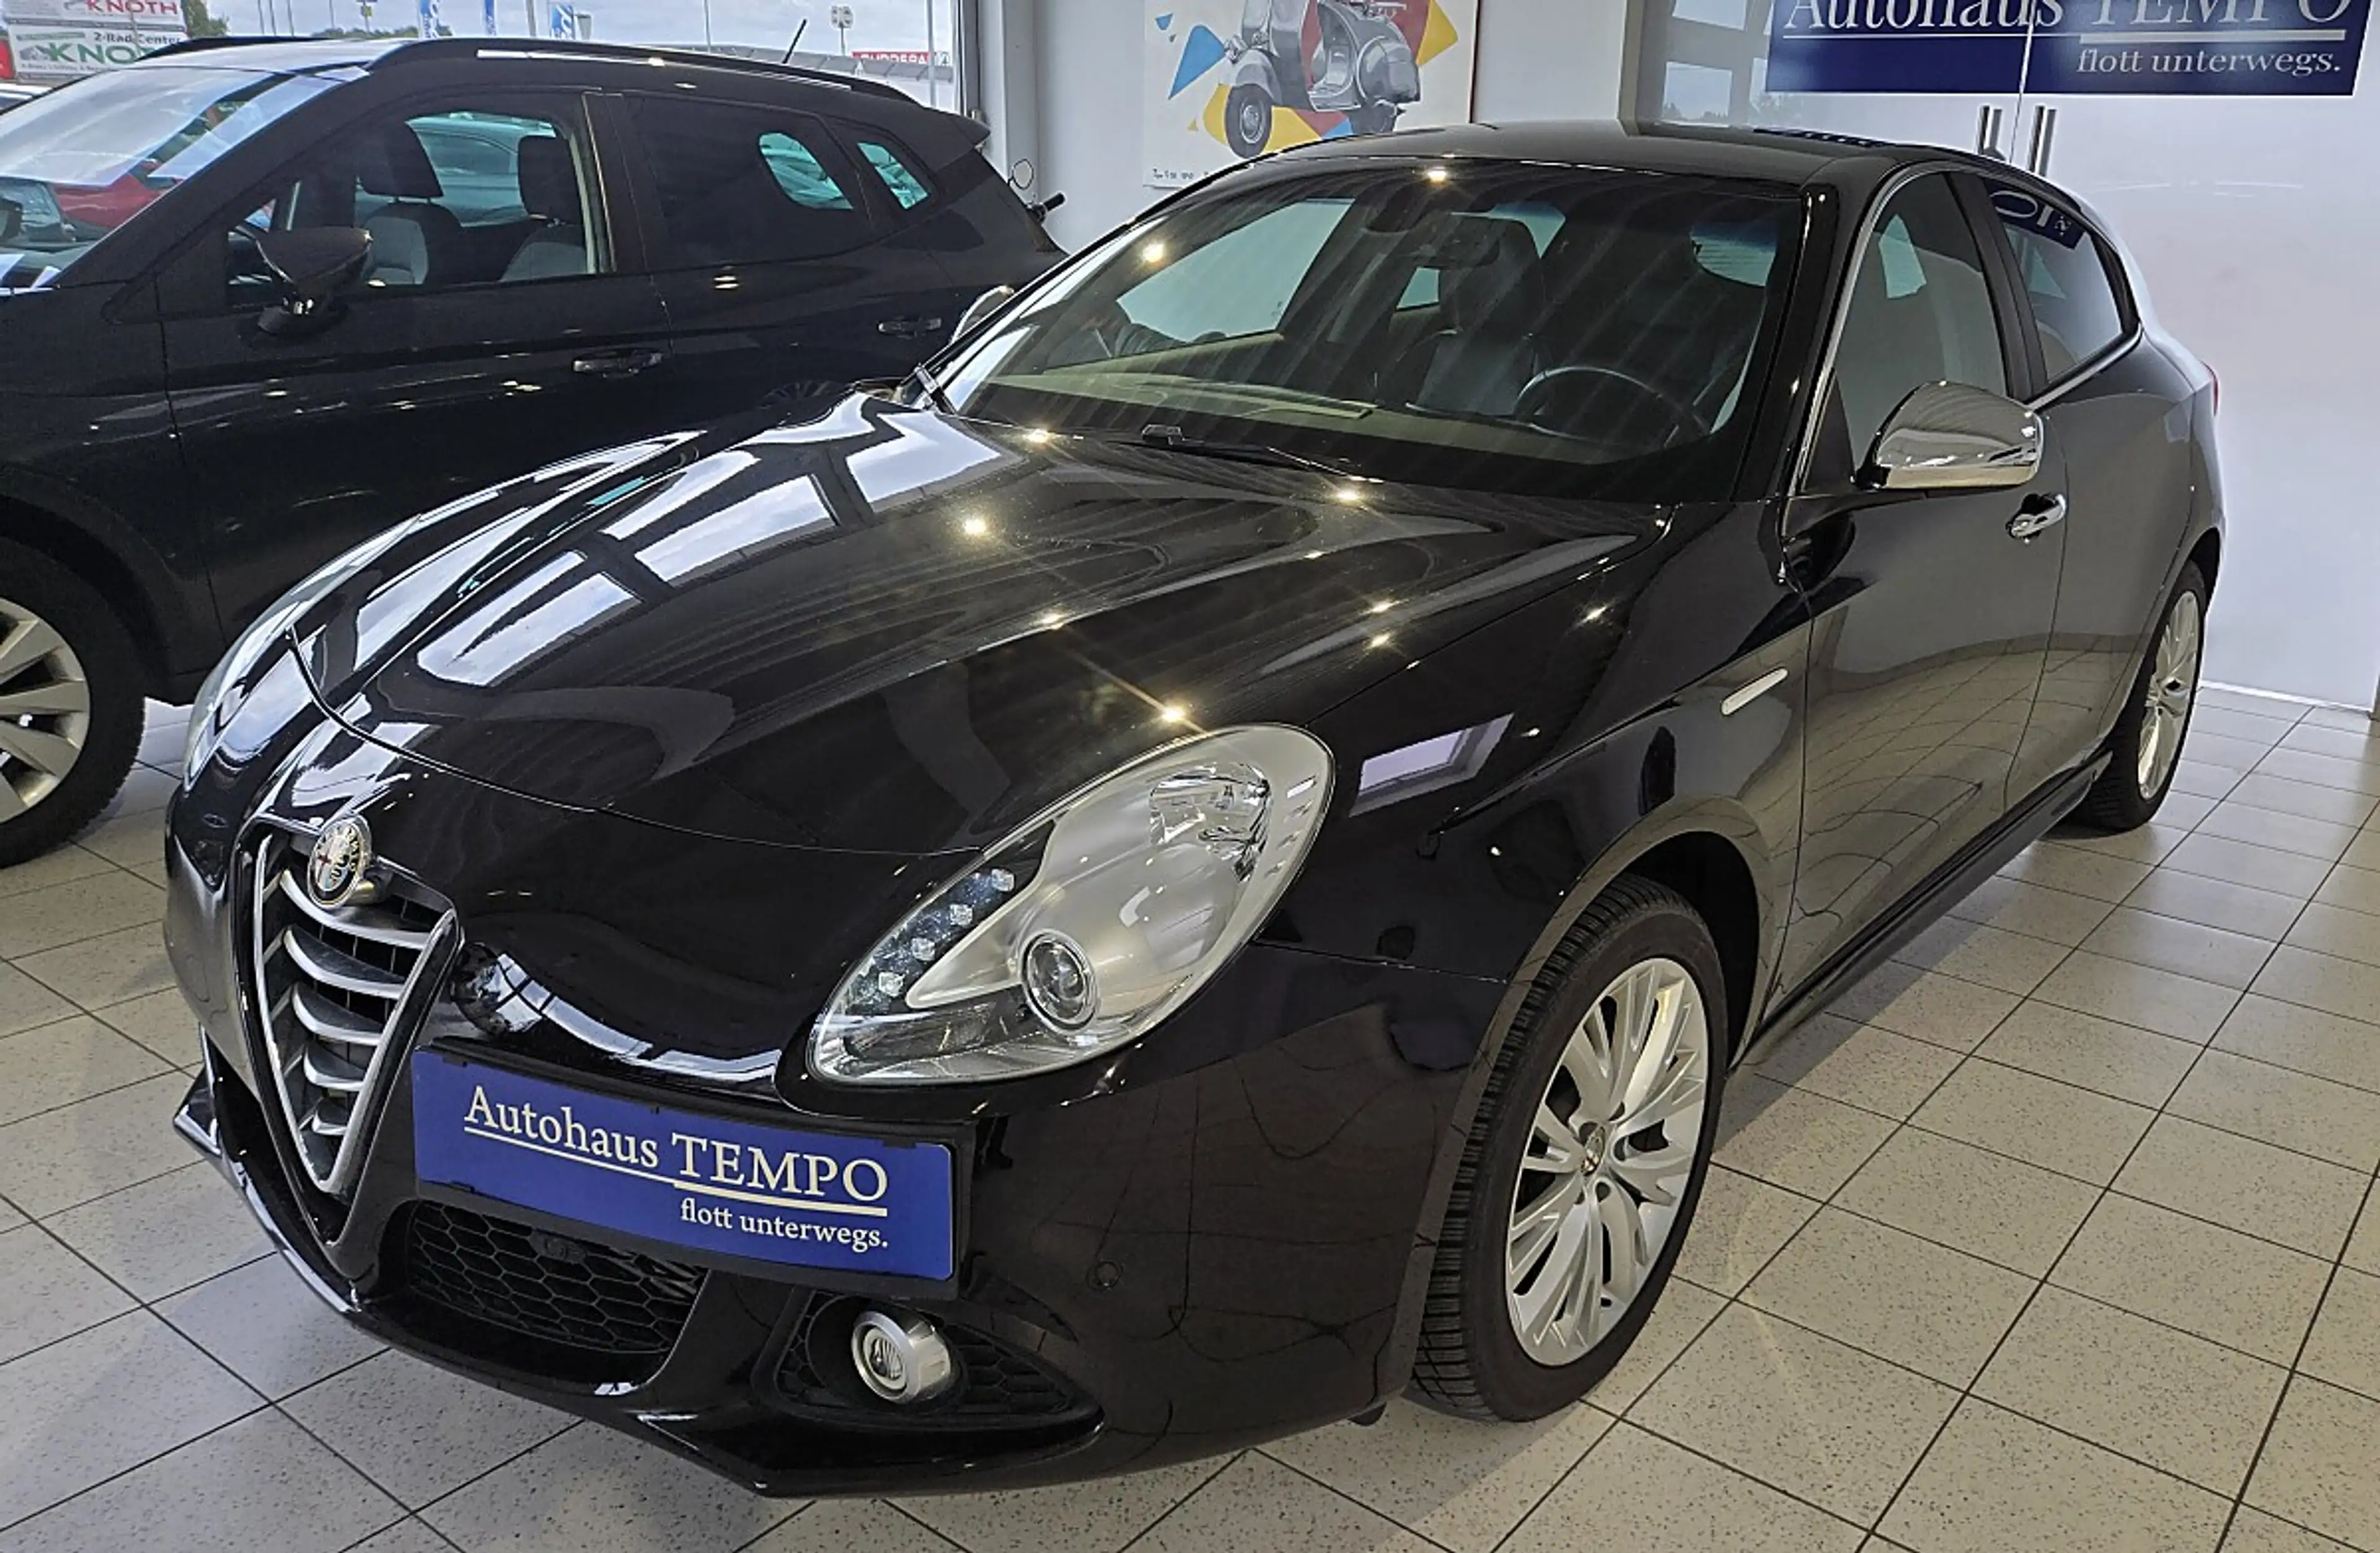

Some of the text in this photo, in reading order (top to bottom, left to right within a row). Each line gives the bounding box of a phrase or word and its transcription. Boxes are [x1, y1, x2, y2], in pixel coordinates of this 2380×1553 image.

[85, 0, 178, 14] KNOTH
[94, 32, 132, 42] 2-Rad
[2076, 49, 2341, 77] flott unterwegs.
[464, 1084, 888, 1201] Autohaus TEMPO
[681, 1198, 888, 1253] flott unterwegs.
